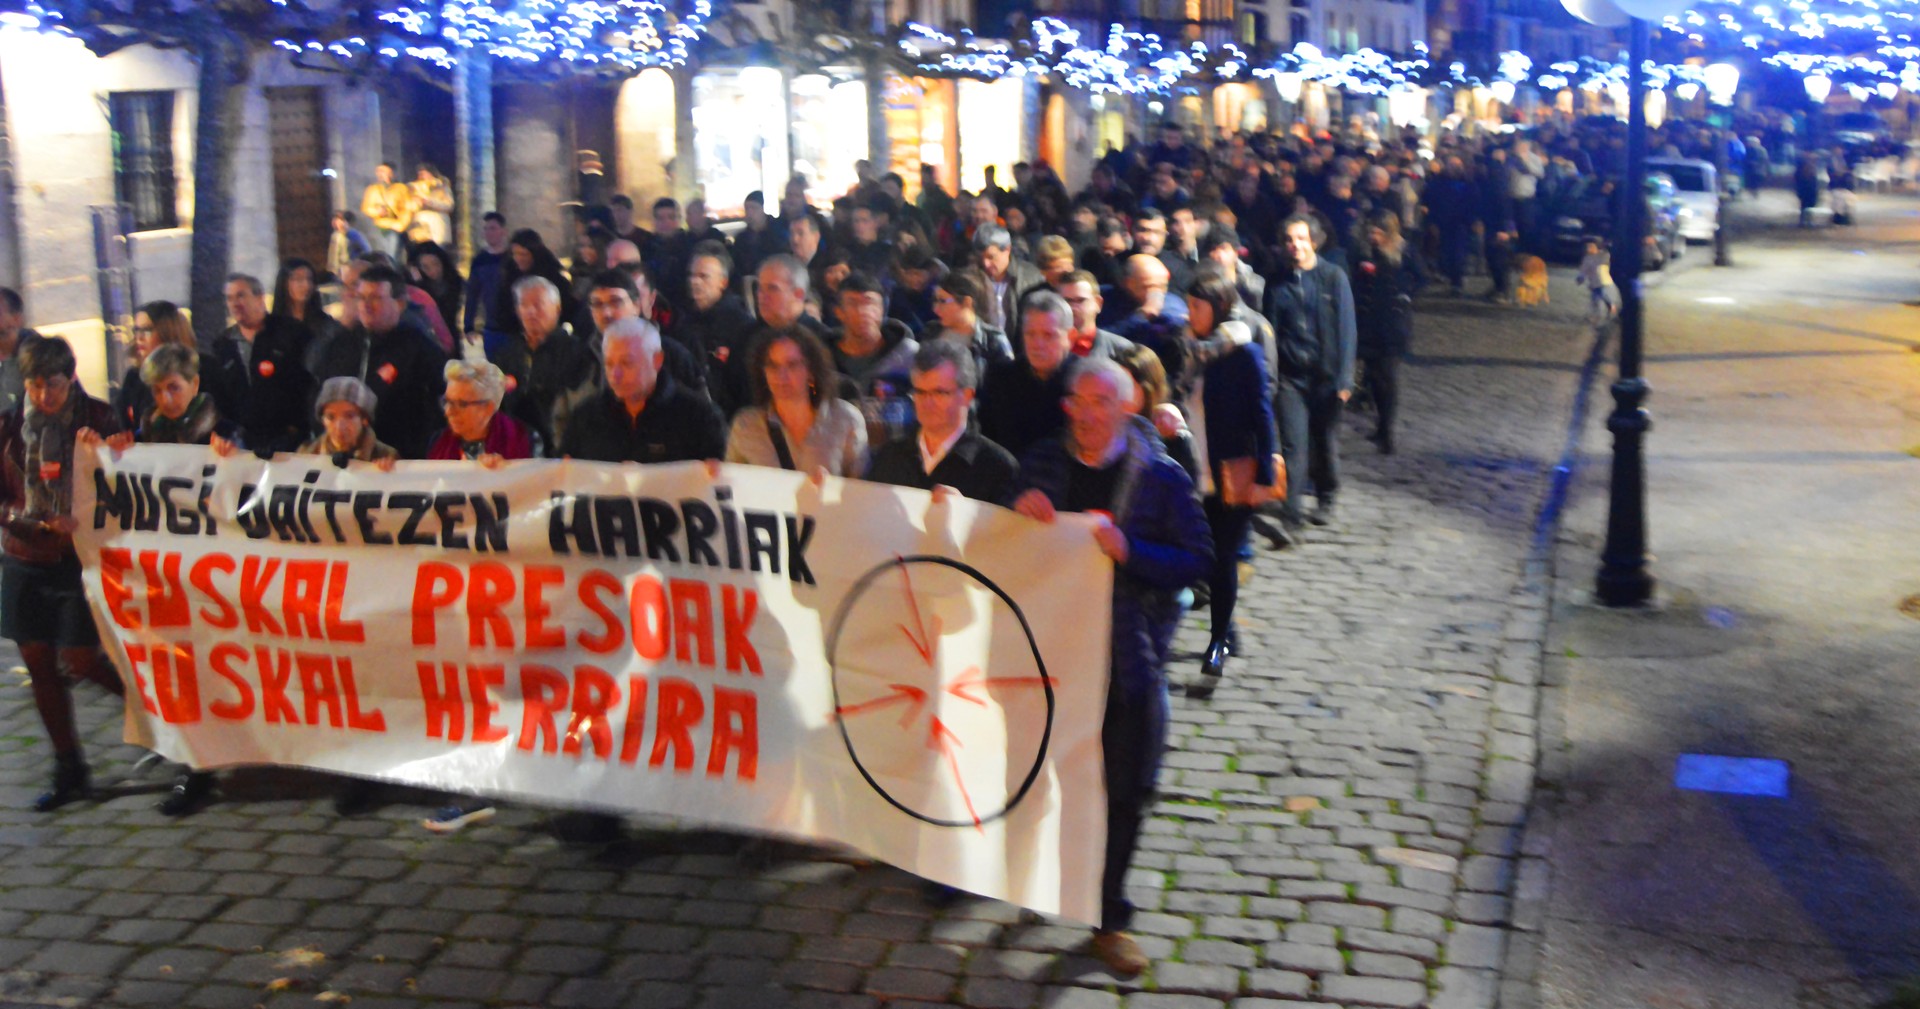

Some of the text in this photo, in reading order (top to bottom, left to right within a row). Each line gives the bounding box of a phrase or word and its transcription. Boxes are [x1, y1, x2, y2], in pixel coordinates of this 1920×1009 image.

[100, 547, 764, 677] EUSKAL PRESOAK
[122, 639, 759, 782] EUSKAL HERRIRA
